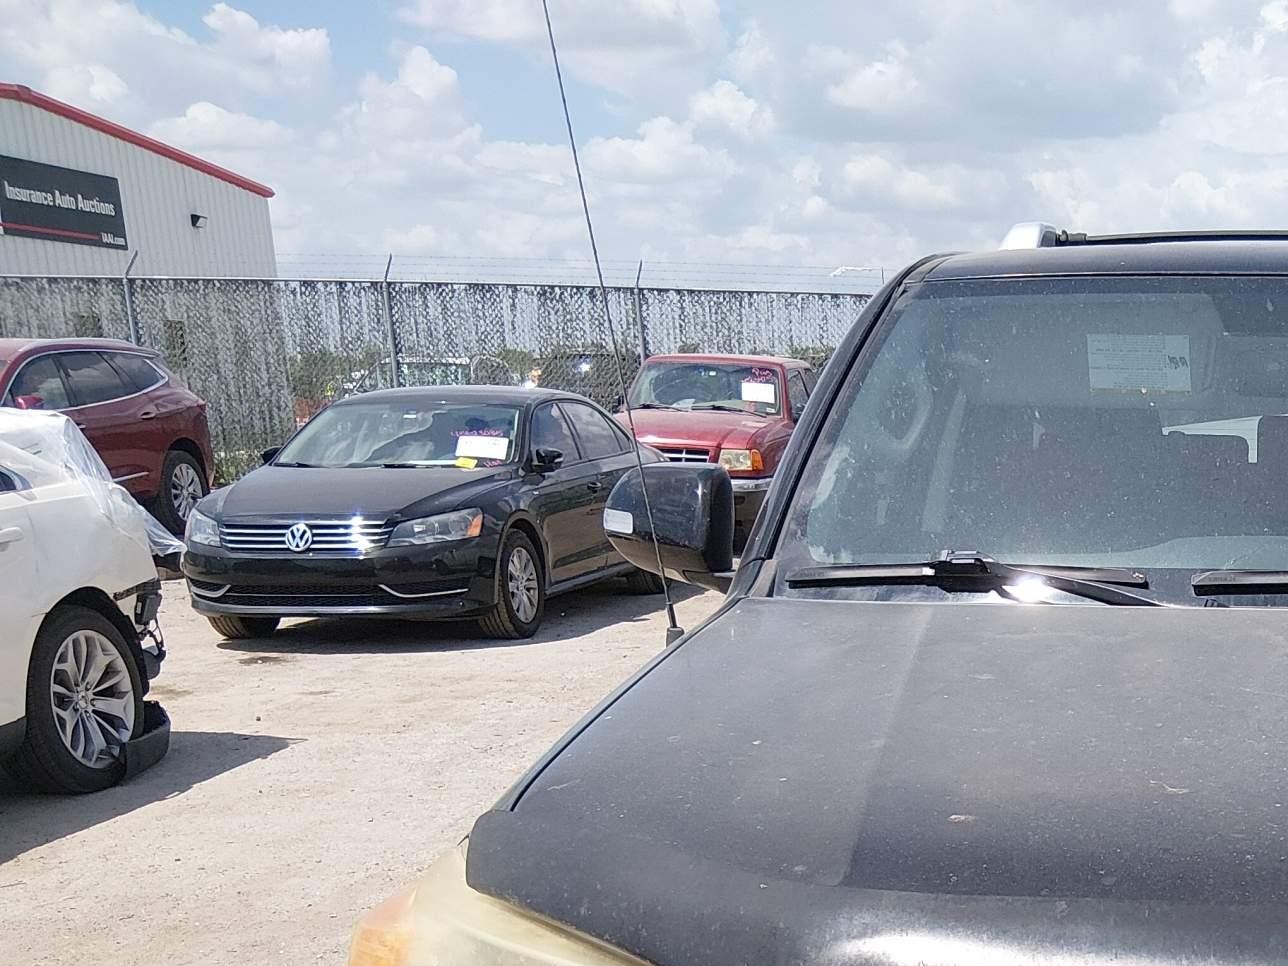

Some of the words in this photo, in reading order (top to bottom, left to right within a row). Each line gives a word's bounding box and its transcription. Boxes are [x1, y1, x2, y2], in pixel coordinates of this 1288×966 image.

[4, 180, 54, 206] Insurance
[54, 189, 76, 210] Auto
[77, 193, 116, 216] Auctions
